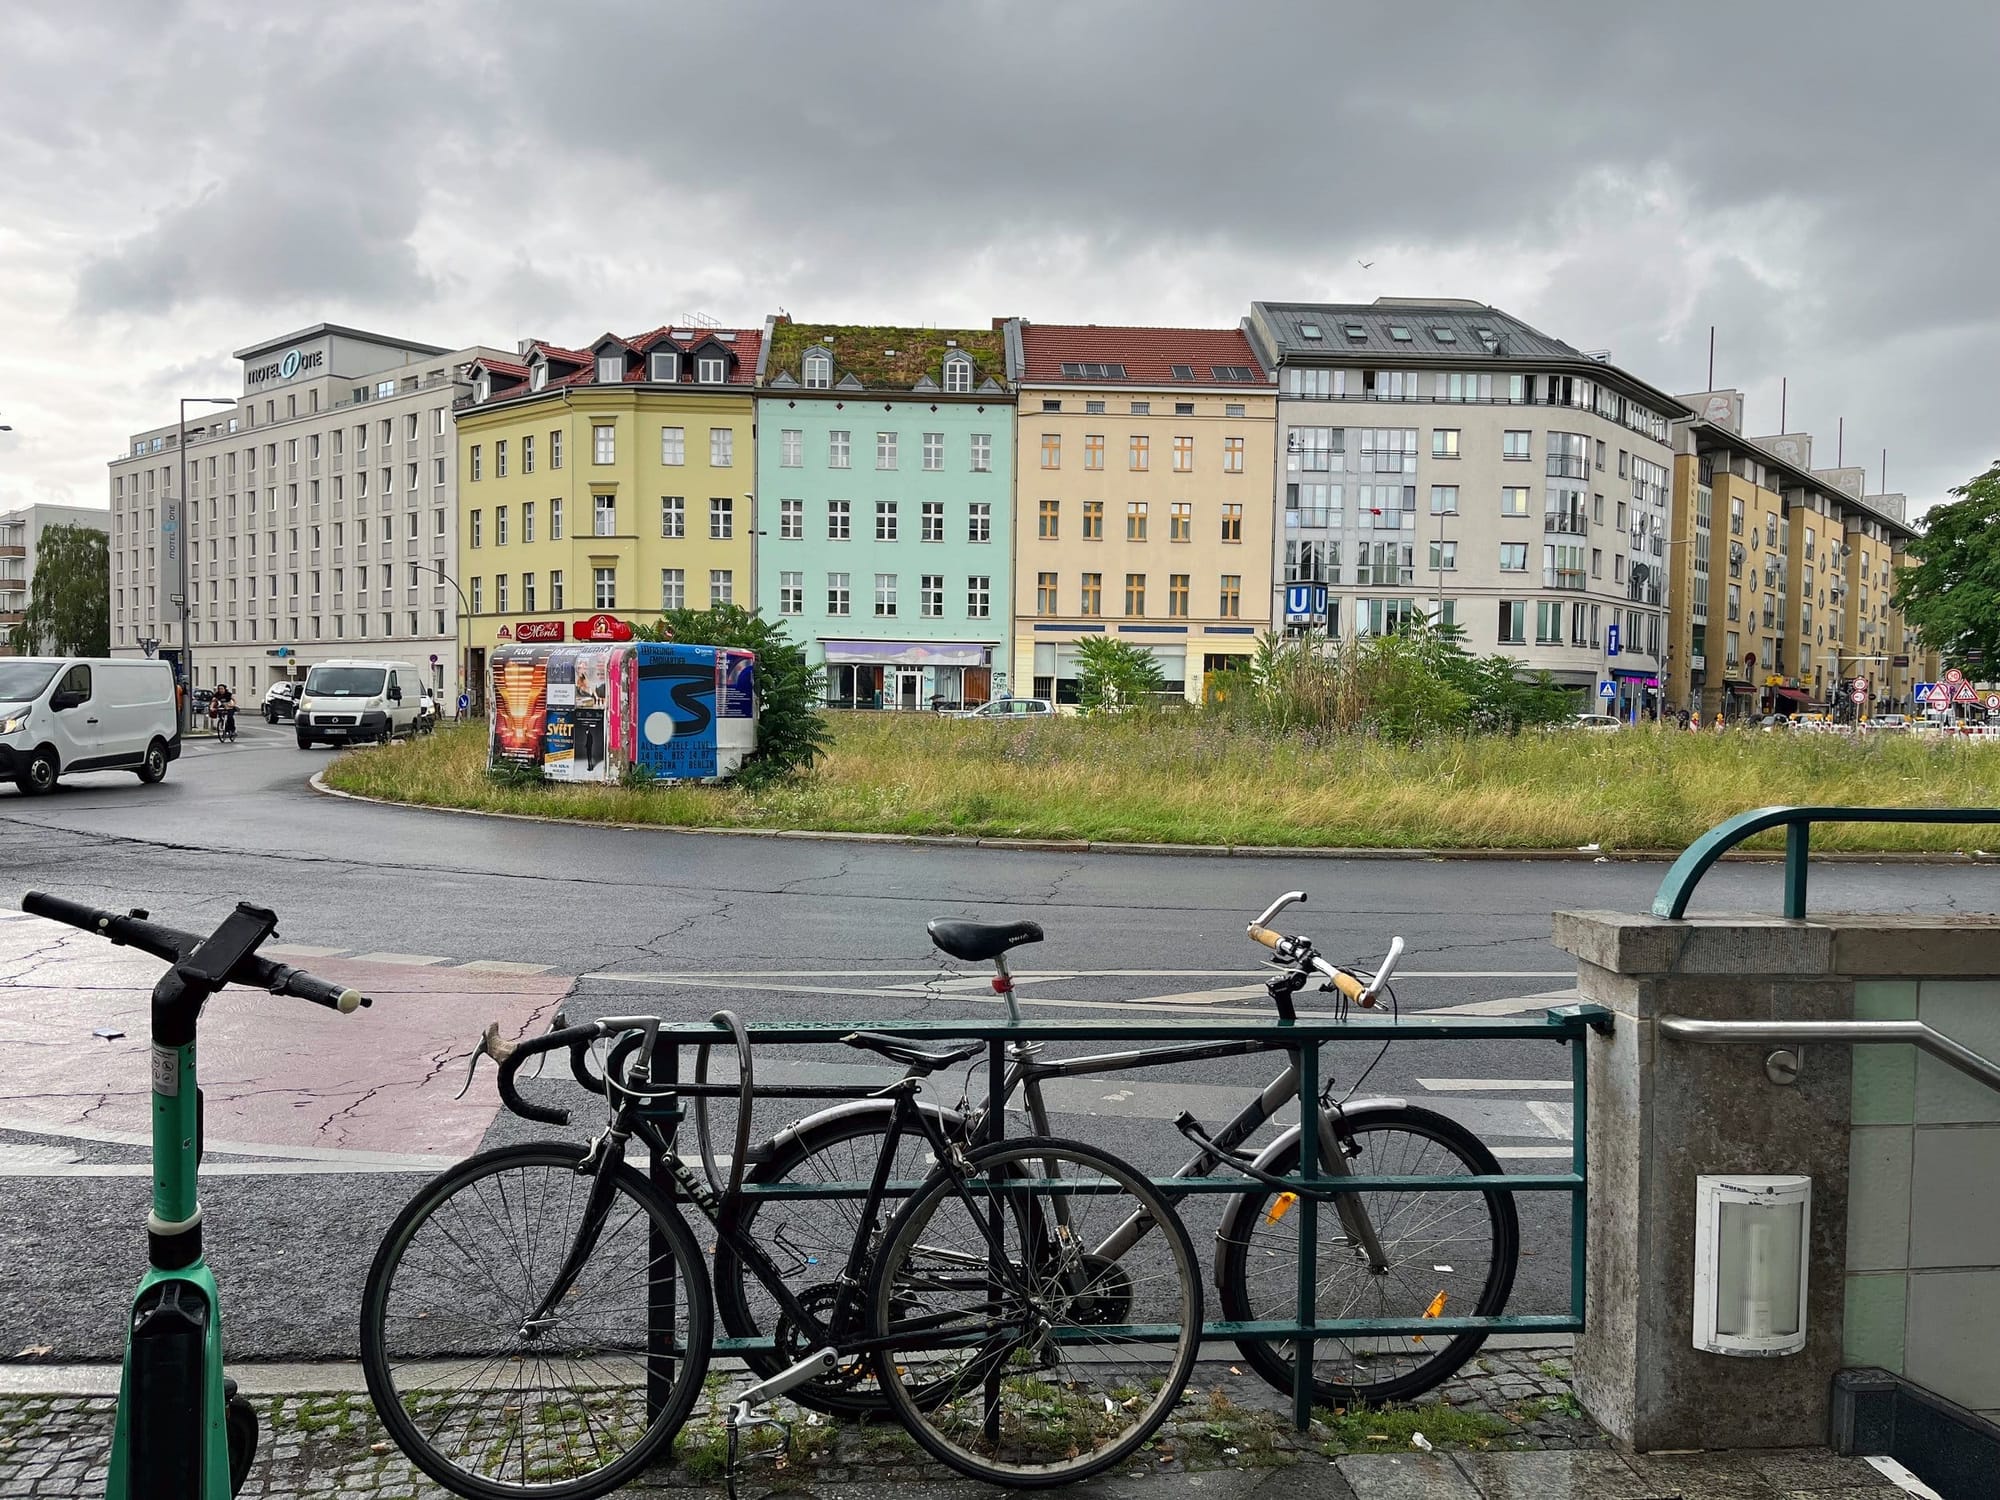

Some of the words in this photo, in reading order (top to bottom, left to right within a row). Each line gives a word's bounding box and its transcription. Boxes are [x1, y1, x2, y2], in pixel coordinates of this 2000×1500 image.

[1290, 589, 1307, 612] U
[1316, 589, 1325, 612] U
[688, 761, 714, 769] BERLIN
[675, 1166, 719, 1219] BIRIA
